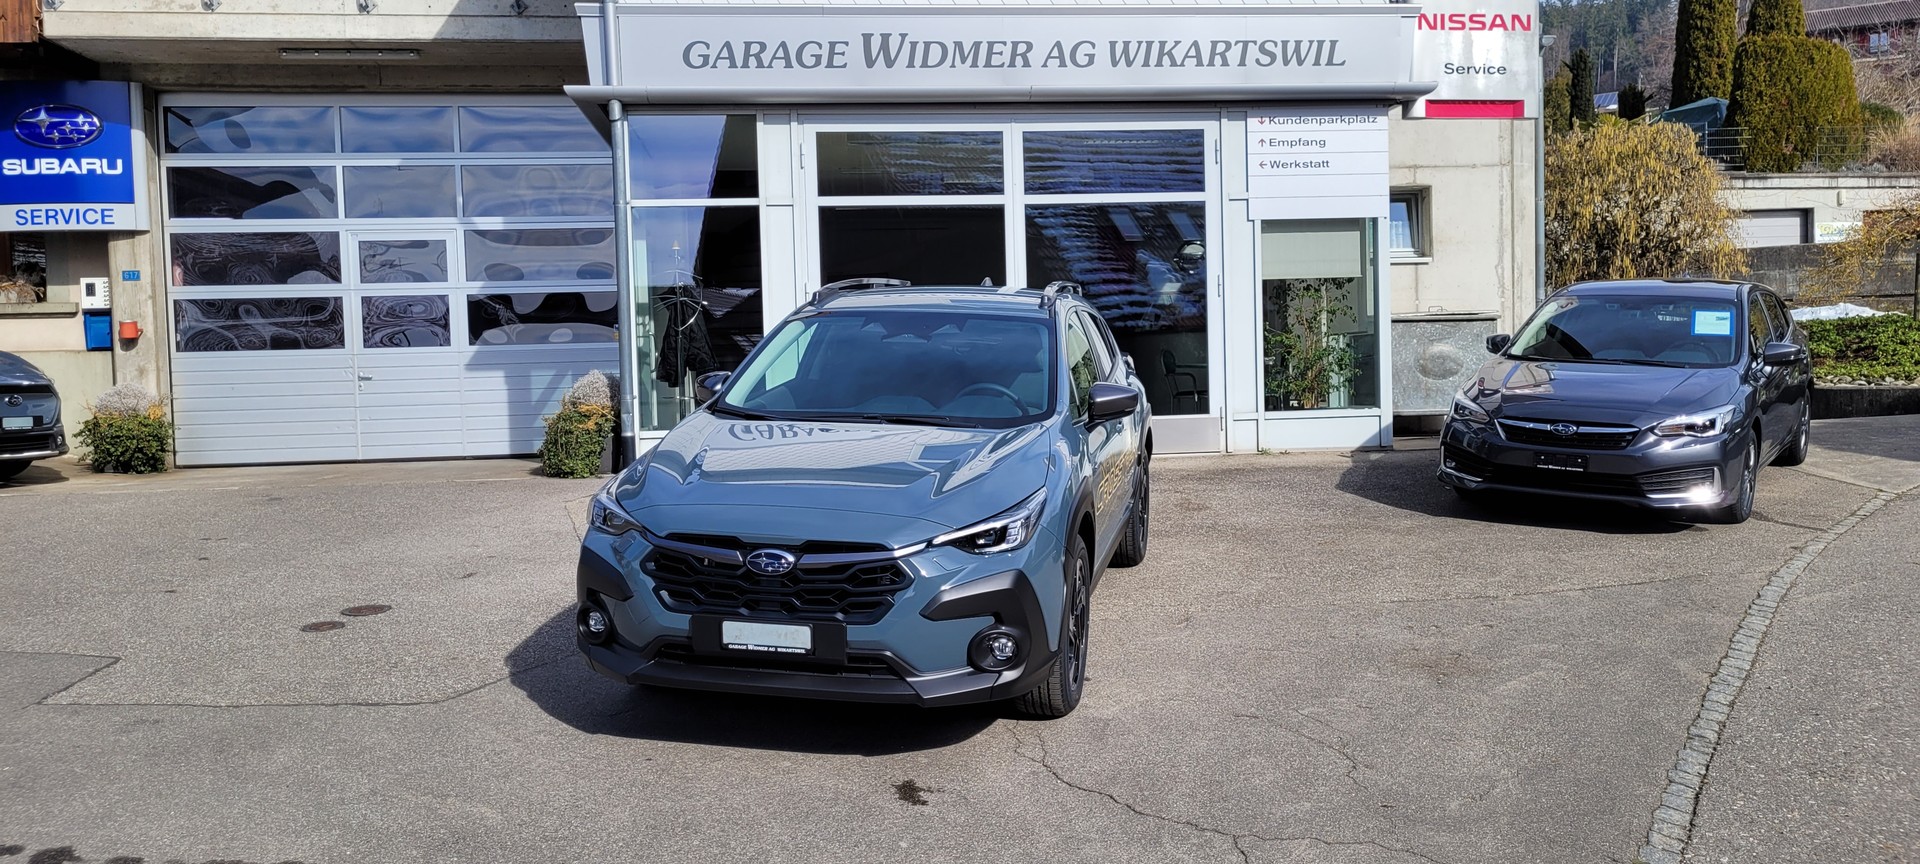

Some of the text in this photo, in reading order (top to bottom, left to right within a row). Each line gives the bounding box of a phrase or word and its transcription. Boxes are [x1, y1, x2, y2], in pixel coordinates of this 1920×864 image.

[1417, 13, 1532, 32] NISSAN
[682, 32, 1347, 69] GARAGE WIDMER AG WIKARTSWIL
[1443, 62, 1508, 76] Service
[1268, 115, 1379, 127] Kundenparkplatz
[1268, 137, 1327, 149] Empfang
[2, 157, 123, 176] SUBARU
[1269, 159, 1331, 170] Werkstatt
[15, 207, 116, 226] SERVICE
[124, 271, 139, 280] 617
